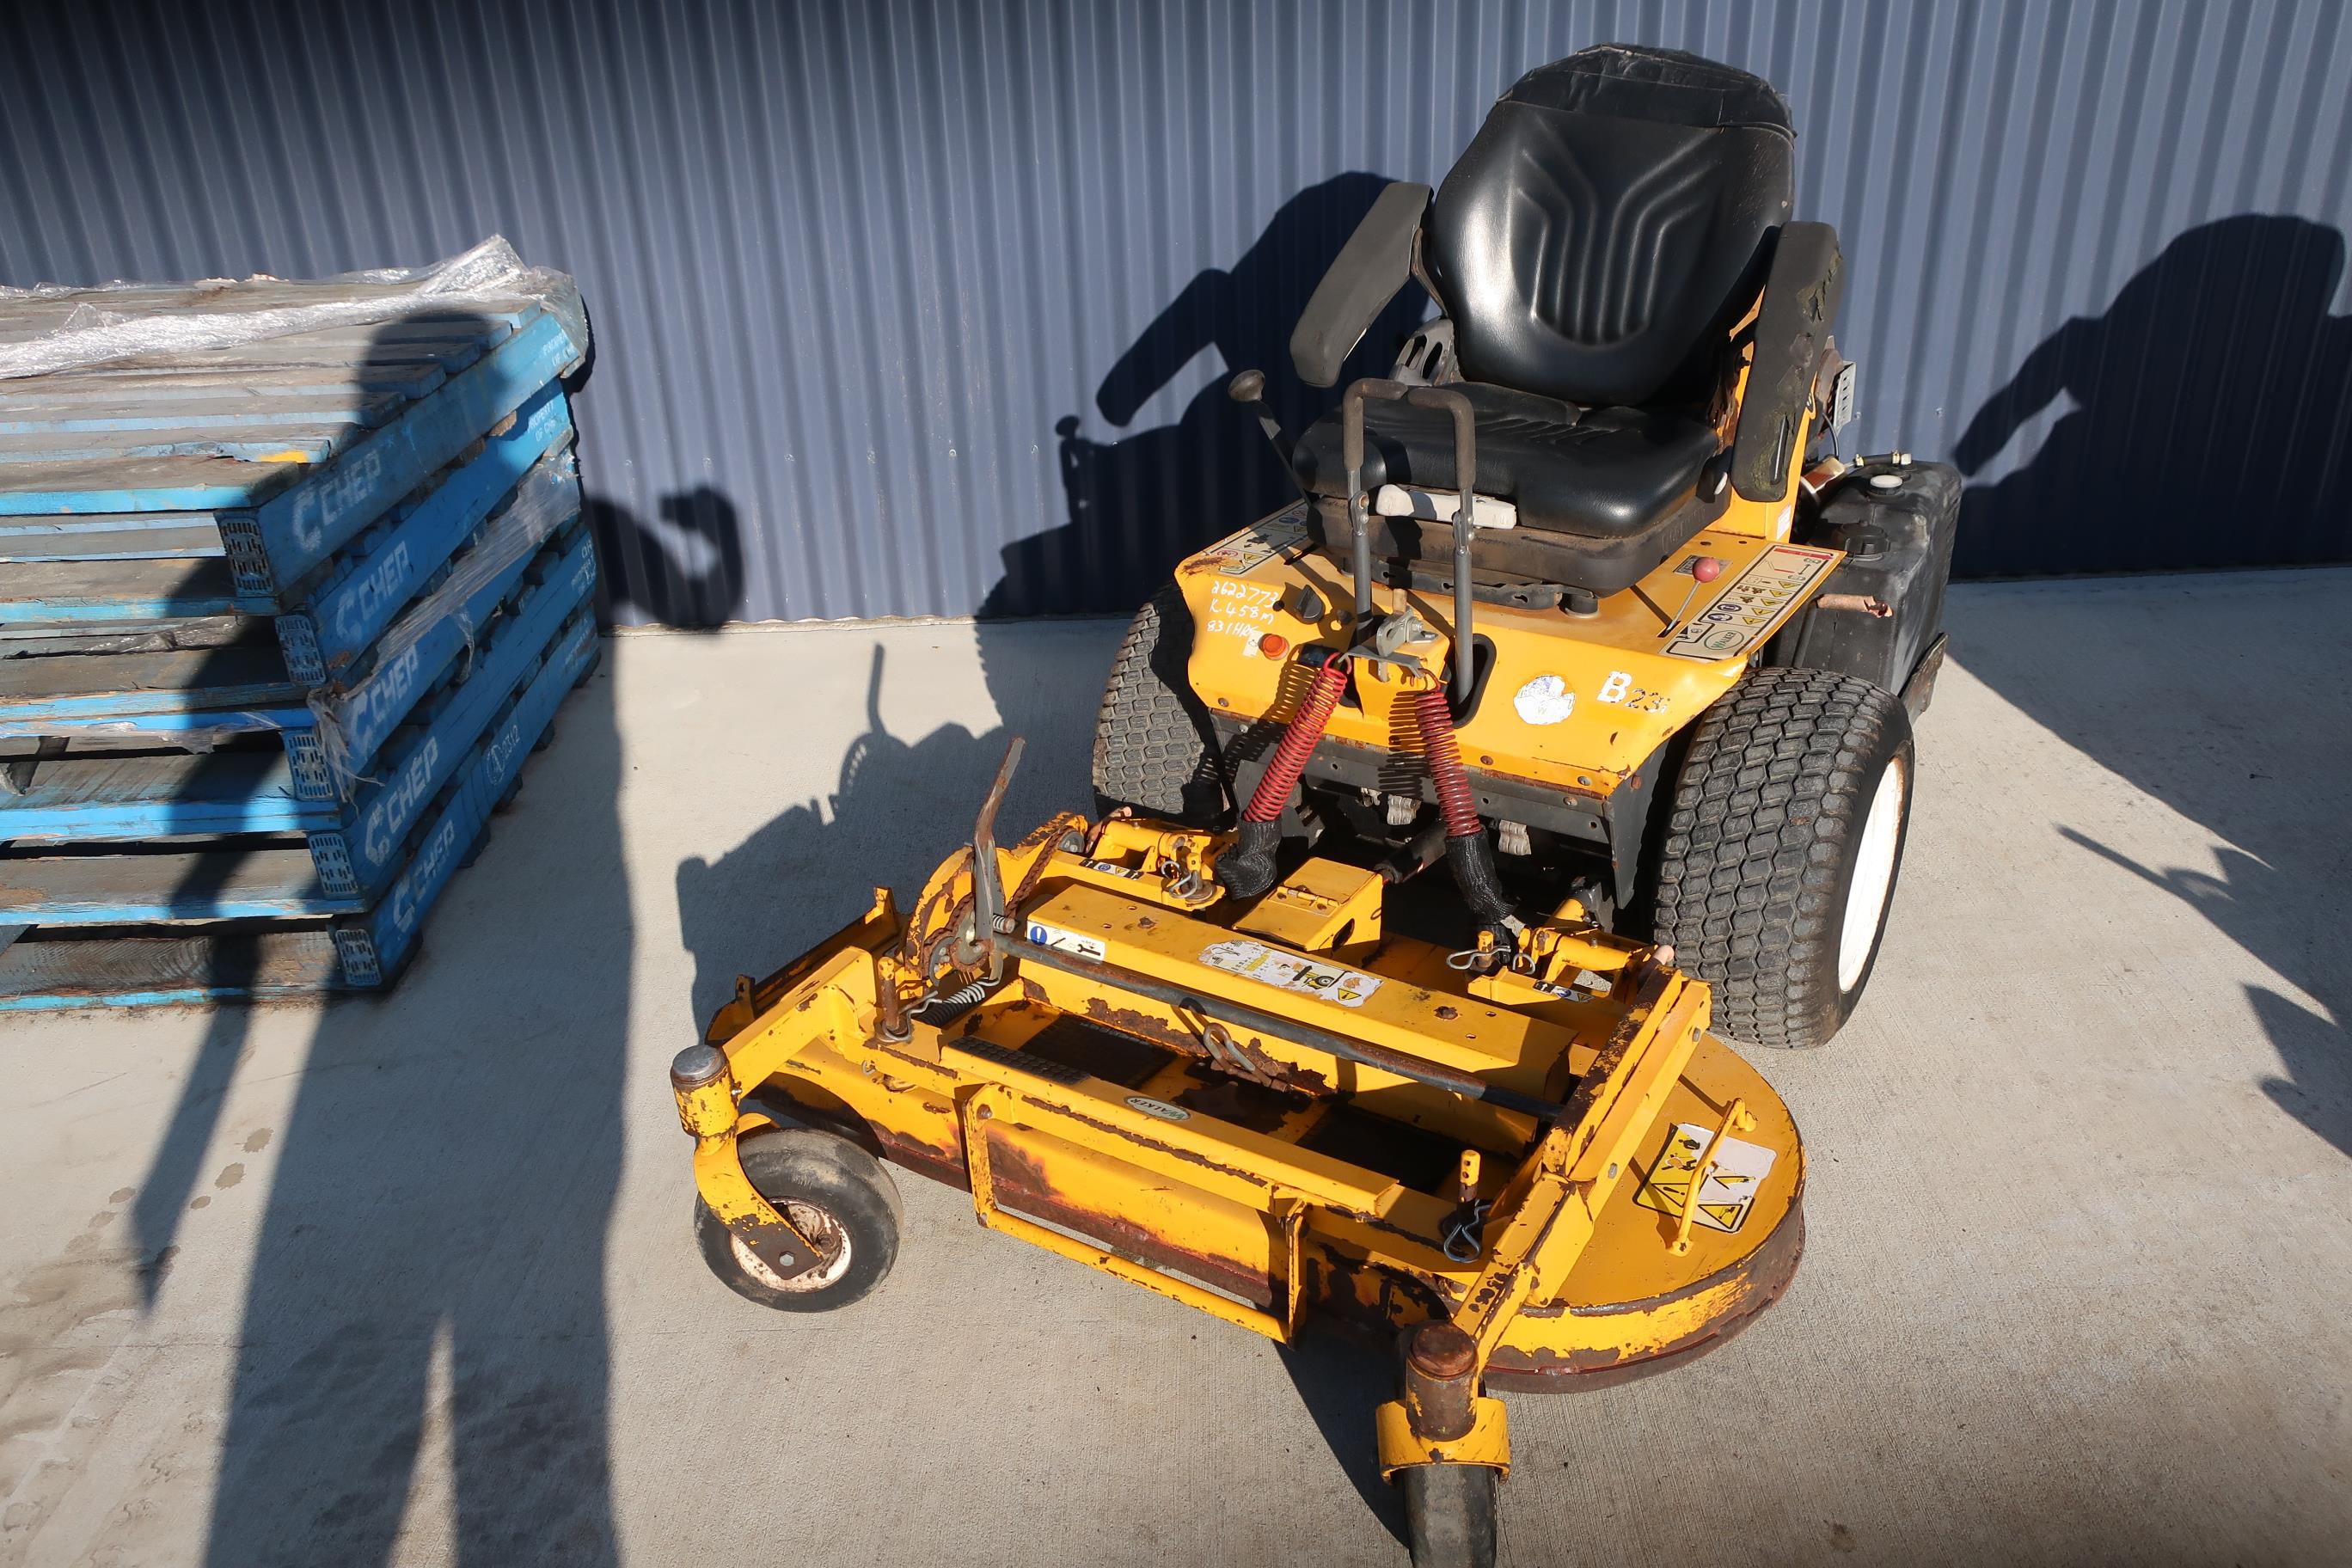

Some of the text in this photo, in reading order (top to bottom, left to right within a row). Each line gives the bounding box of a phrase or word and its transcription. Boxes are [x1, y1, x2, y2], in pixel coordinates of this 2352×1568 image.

[358, 541, 410, 622] CHEP
[370, 644, 419, 725] CHEP
[386, 736, 439, 834] CHEP
[1130, 1098, 1185, 1120] WALKER
